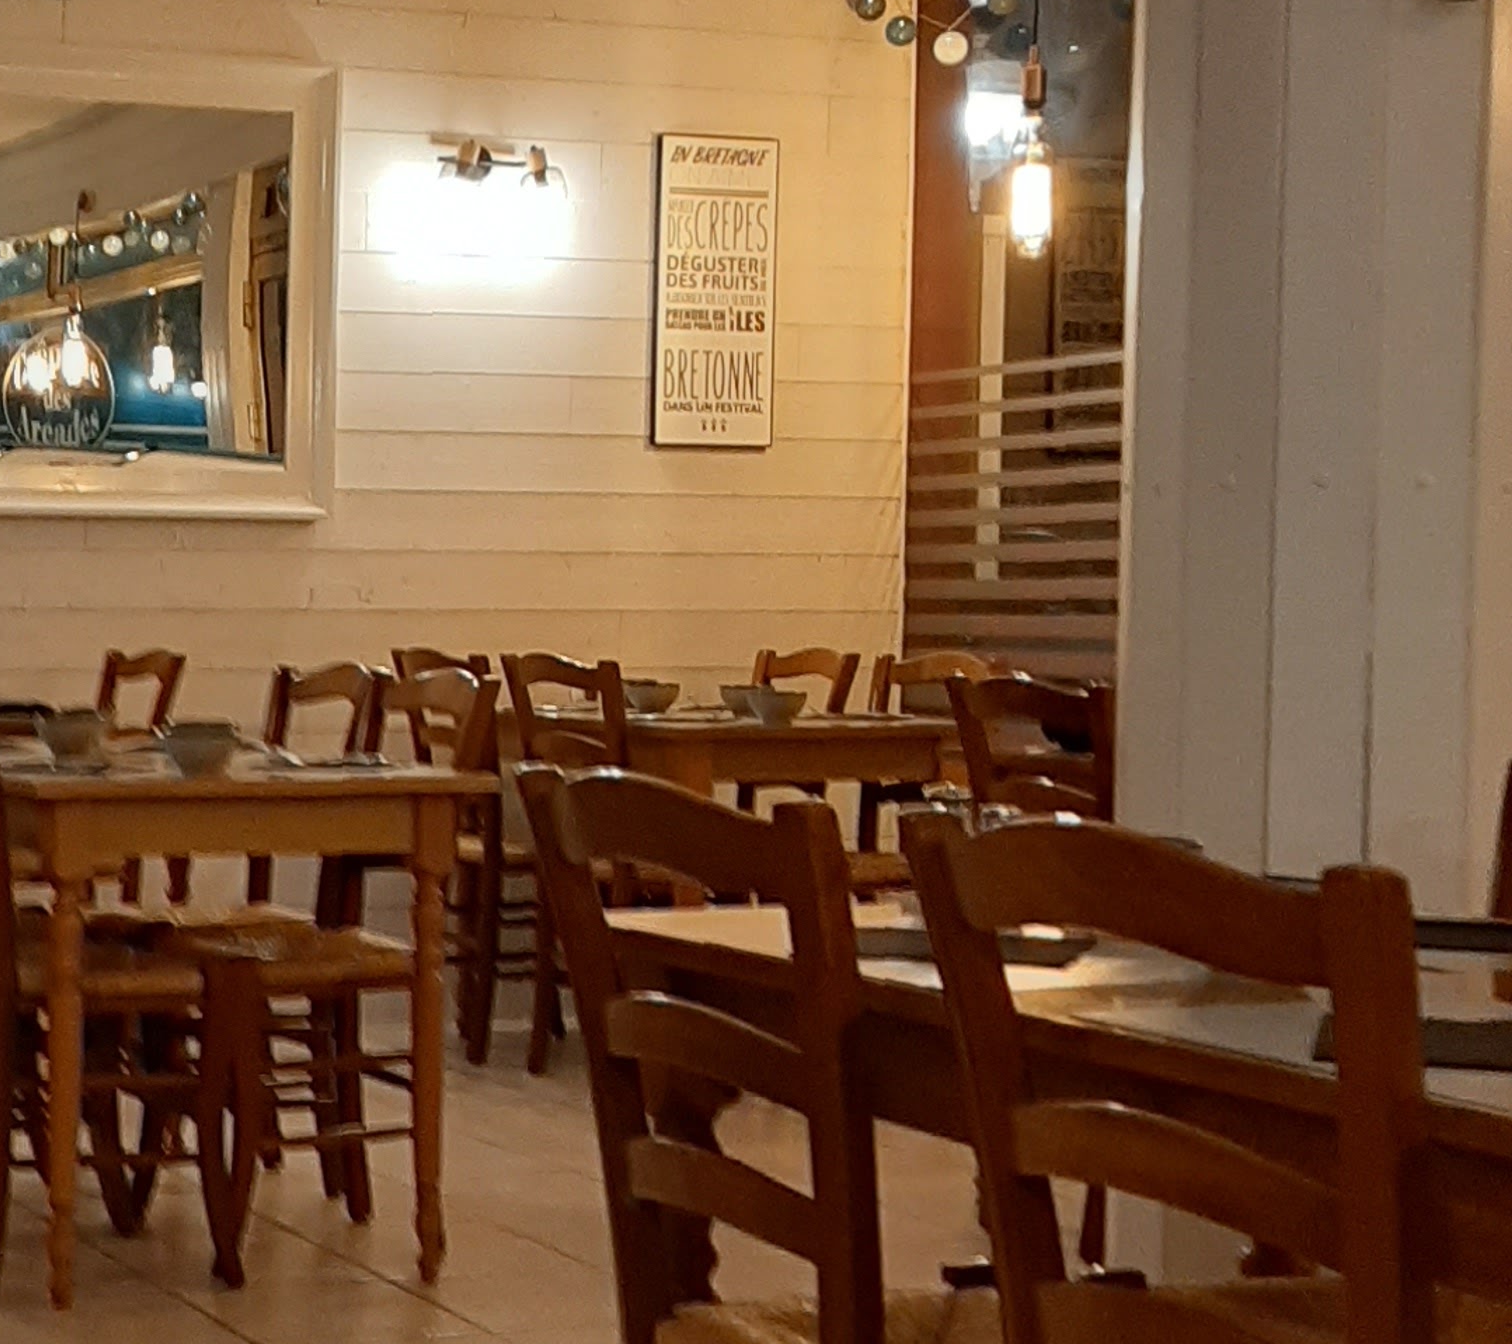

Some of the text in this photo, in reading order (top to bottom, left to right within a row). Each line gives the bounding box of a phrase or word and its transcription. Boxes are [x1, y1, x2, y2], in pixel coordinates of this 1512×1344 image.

[671, 145, 770, 167] EN BRETAGNE
[667, 214, 694, 250] DES
[666, 250, 760, 274] DÉGUSTER
[665, 272, 698, 289] DES
[701, 274, 759, 292] FRUITS
[663, 348, 765, 402] BRETONNE
[663, 400, 694, 413] DANS
[714, 402, 764, 414] FESTIVAL
